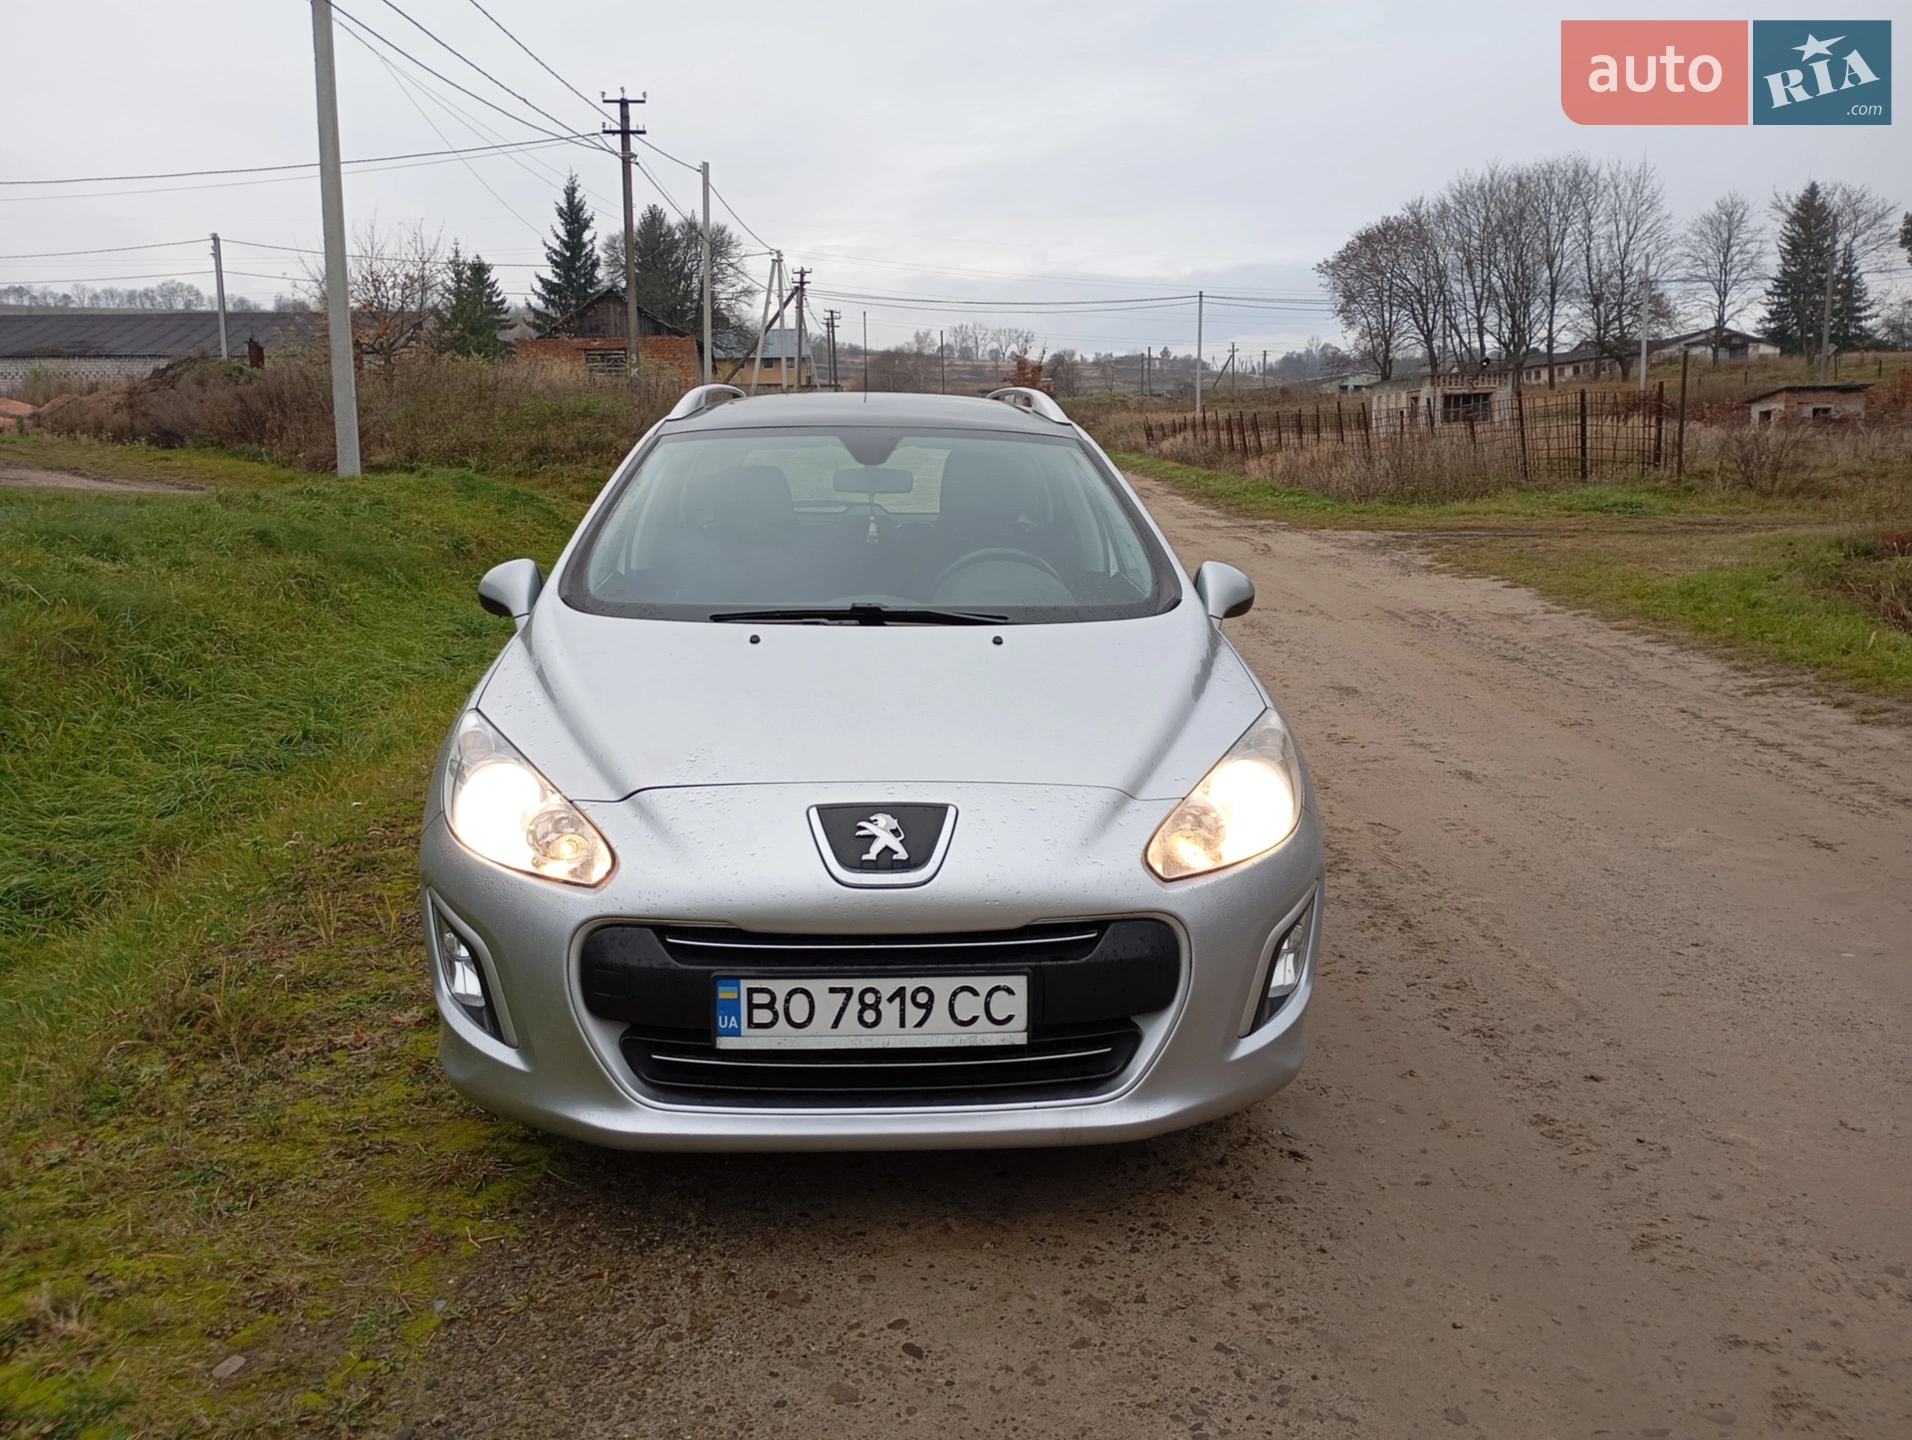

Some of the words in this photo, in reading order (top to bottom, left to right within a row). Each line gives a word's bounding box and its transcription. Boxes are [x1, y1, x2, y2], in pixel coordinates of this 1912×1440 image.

[718, 1015, 738, 1029] UA
[746, 986, 815, 1030] BO
[827, 985, 935, 1030] 7819
[948, 984, 1016, 1027] CC
